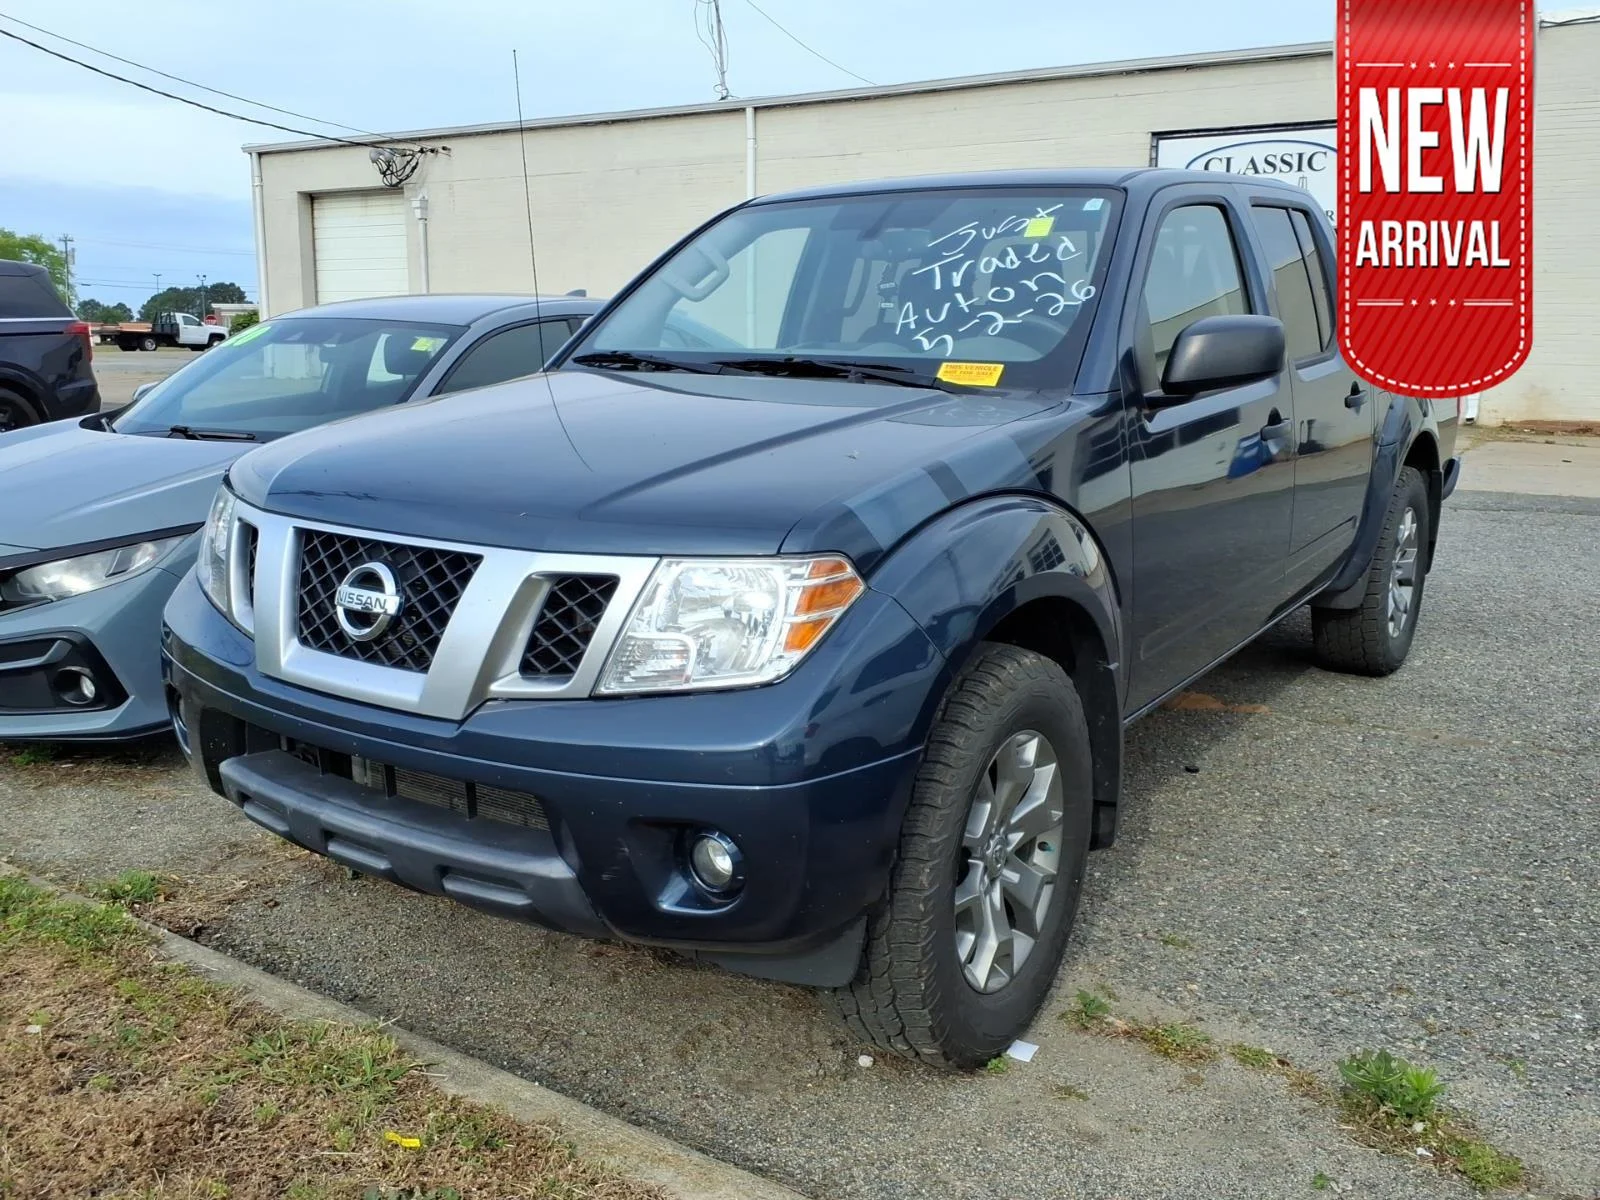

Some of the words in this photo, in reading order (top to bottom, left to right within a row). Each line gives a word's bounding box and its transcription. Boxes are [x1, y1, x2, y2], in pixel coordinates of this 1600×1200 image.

[1204, 150, 1328, 176] CLASSIC
[912, 235, 1083, 290] Traded
[337, 589, 388, 610] NISSAN
